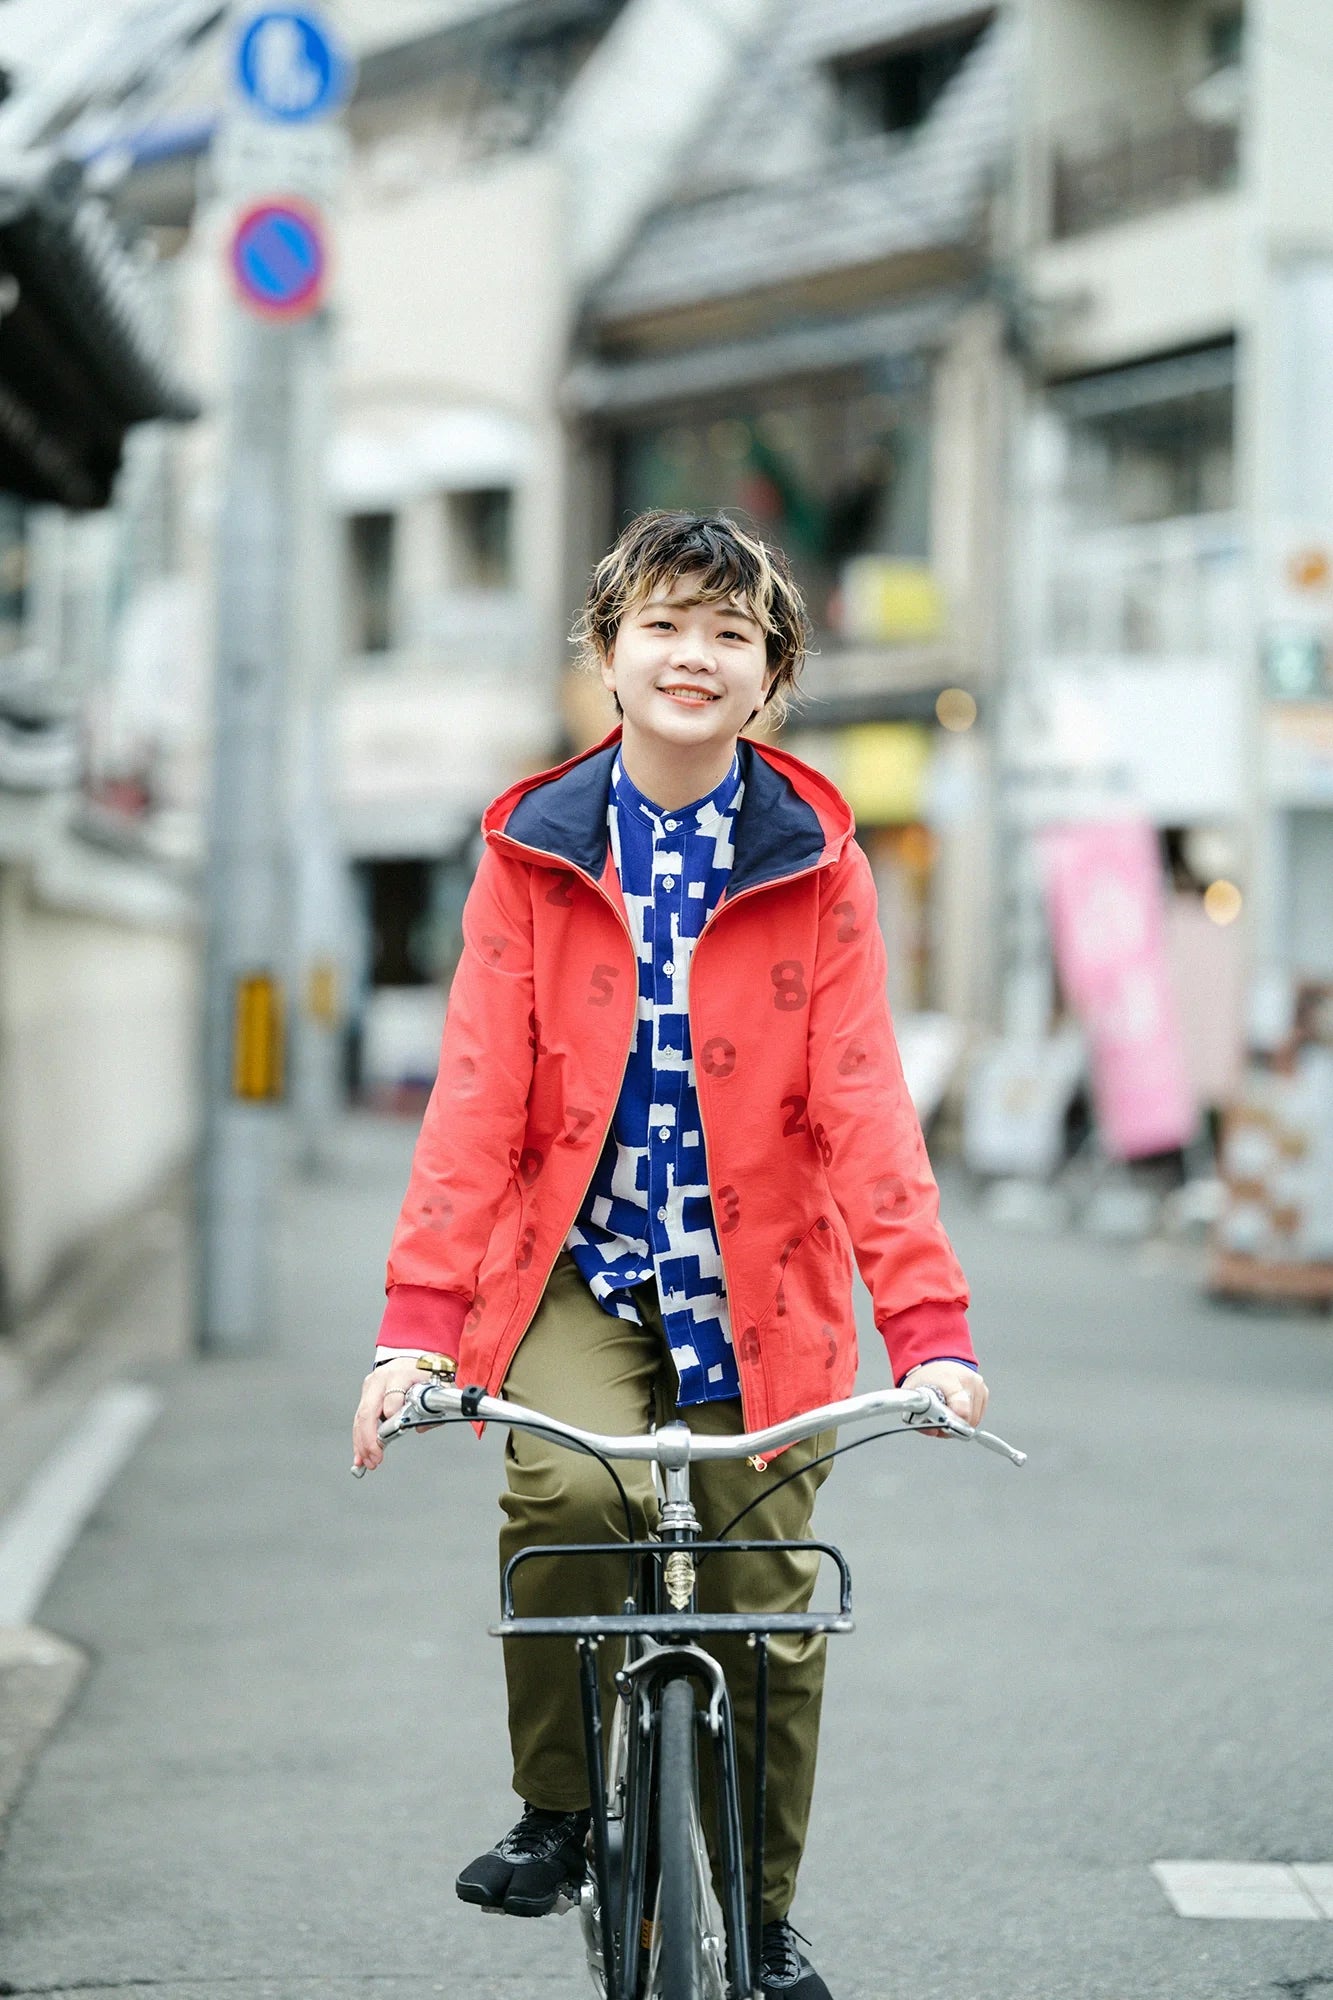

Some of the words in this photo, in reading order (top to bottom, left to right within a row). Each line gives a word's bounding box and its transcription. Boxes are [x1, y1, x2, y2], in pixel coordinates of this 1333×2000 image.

[546, 868, 574, 908] 2
[833, 901, 859, 943] 2
[587, 964, 620, 1007] 5
[770, 960, 807, 1011] 8
[702, 1037, 736, 1077] 0
[565, 1105, 595, 1144] 7
[780, 1095, 806, 1137] 2
[718, 1184, 740, 1233] 3
